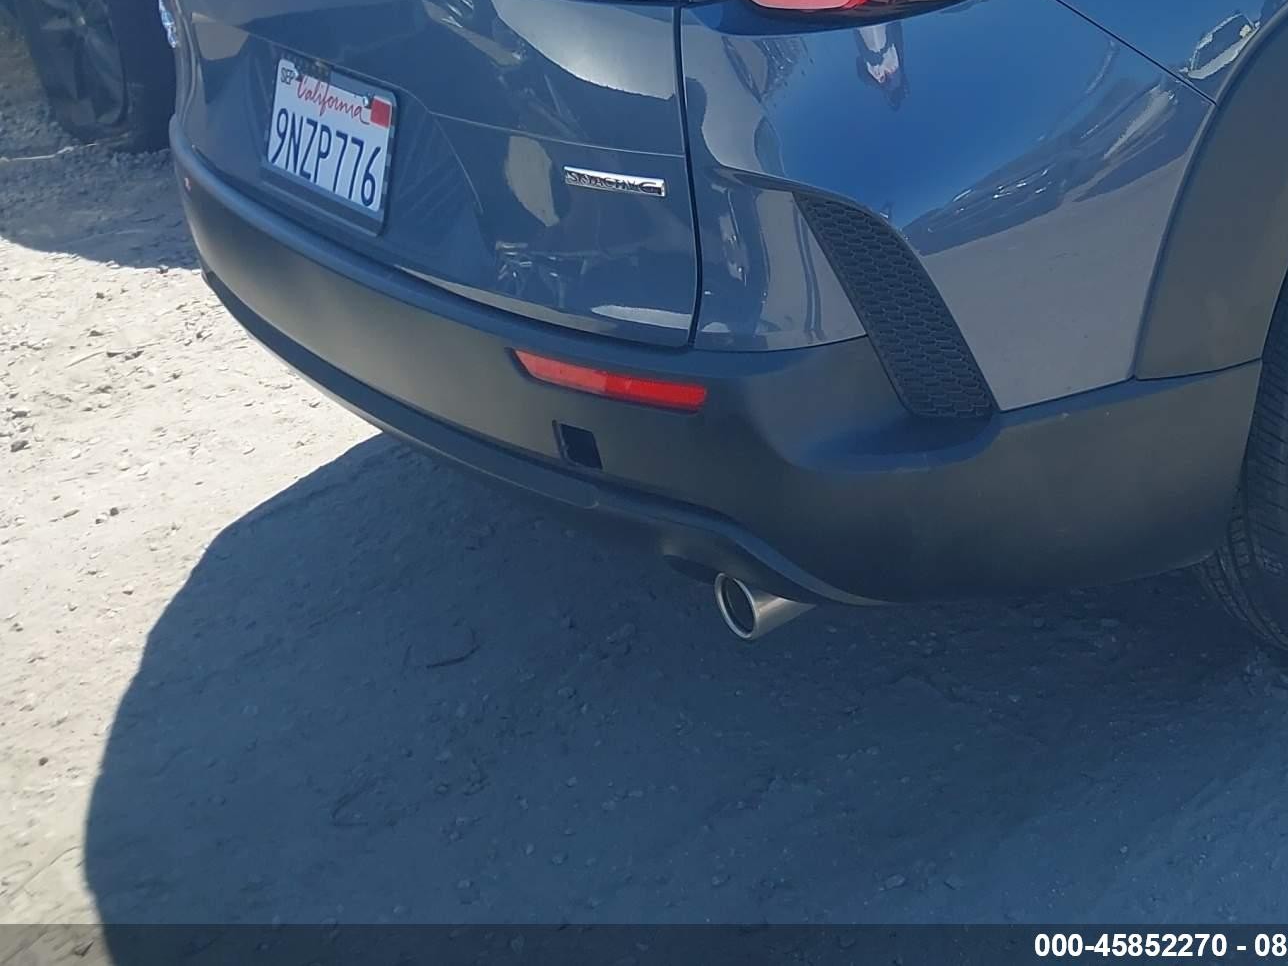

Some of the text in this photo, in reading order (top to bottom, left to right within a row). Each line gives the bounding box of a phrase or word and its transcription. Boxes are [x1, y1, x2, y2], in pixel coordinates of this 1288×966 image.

[280, 67, 295, 84] SEP
[296, 75, 370, 125] California
[271, 108, 381, 207] 9NZP776
